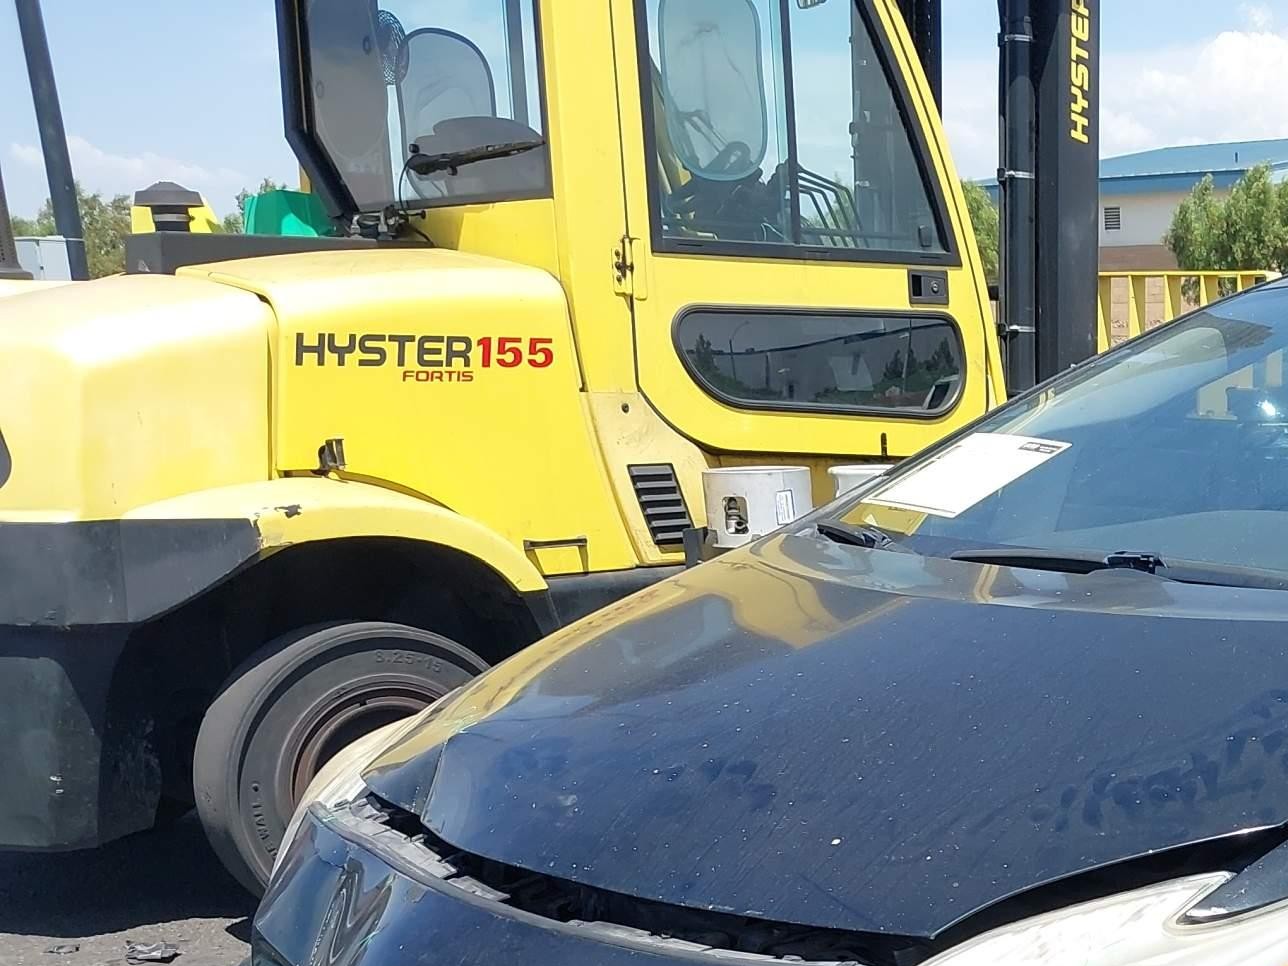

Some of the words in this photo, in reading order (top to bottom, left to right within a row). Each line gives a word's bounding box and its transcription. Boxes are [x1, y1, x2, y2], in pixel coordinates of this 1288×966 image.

[295, 332, 472, 367] HYSTER
[477, 337, 554, 368] 155
[402, 370, 474, 382] FORTIS
